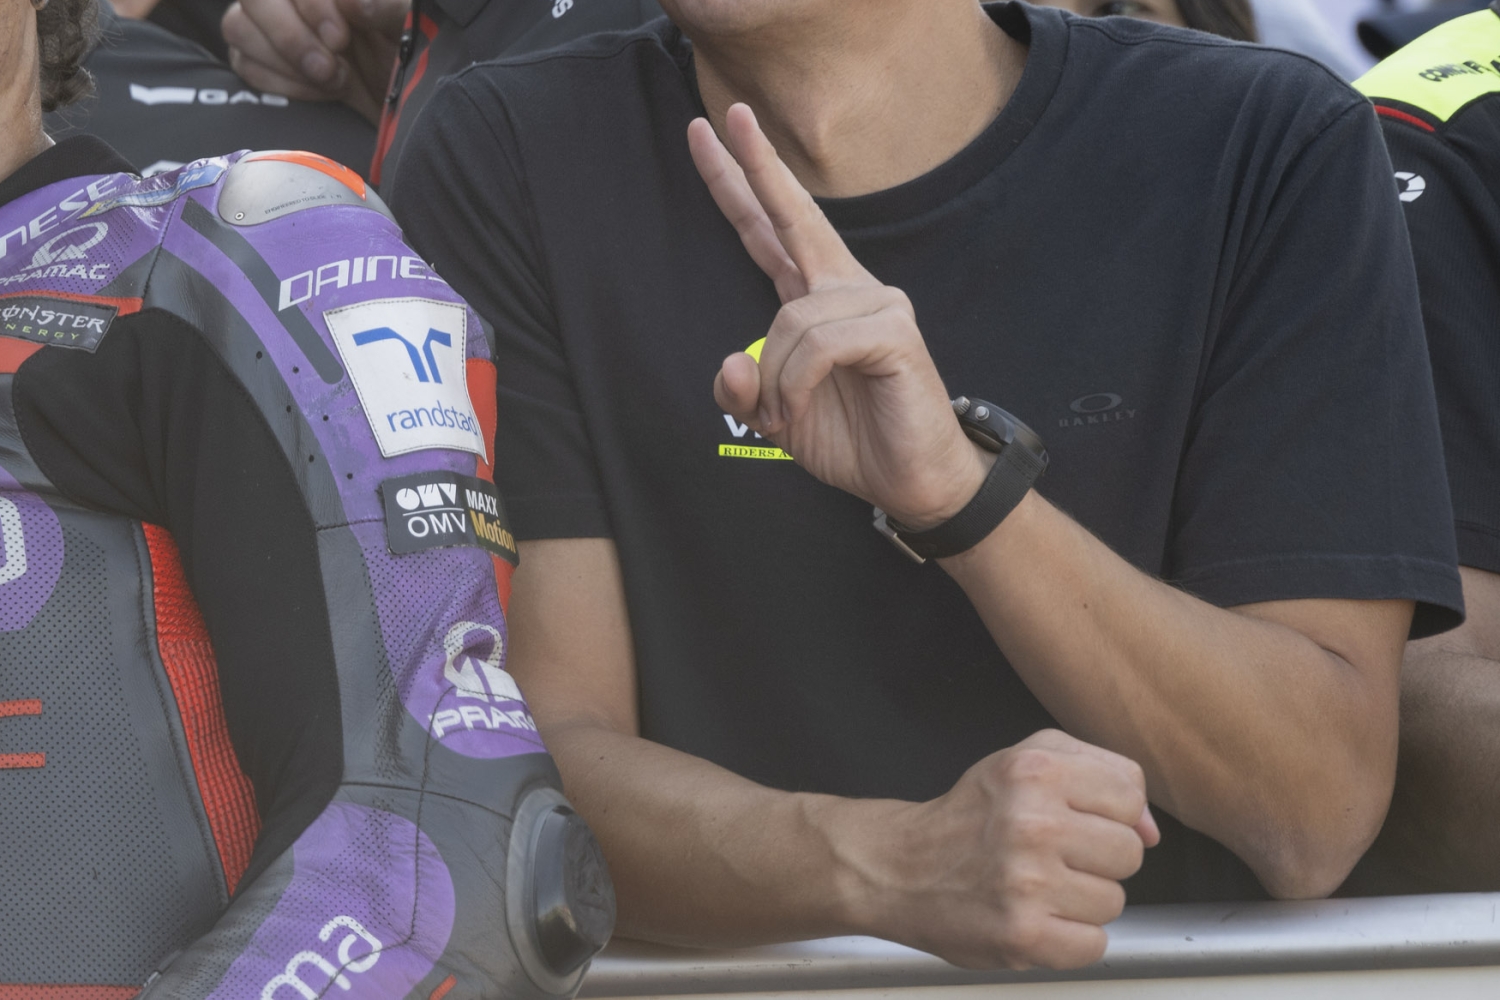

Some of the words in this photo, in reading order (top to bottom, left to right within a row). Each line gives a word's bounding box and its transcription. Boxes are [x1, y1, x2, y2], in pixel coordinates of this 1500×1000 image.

[1058, 408, 1137, 428] OAKLEY
[723, 446, 775, 458] RIDERS
[465, 488, 499, 518] MAXX
[408, 513, 466, 538] OMV
[469, 509, 516, 554] Motion
